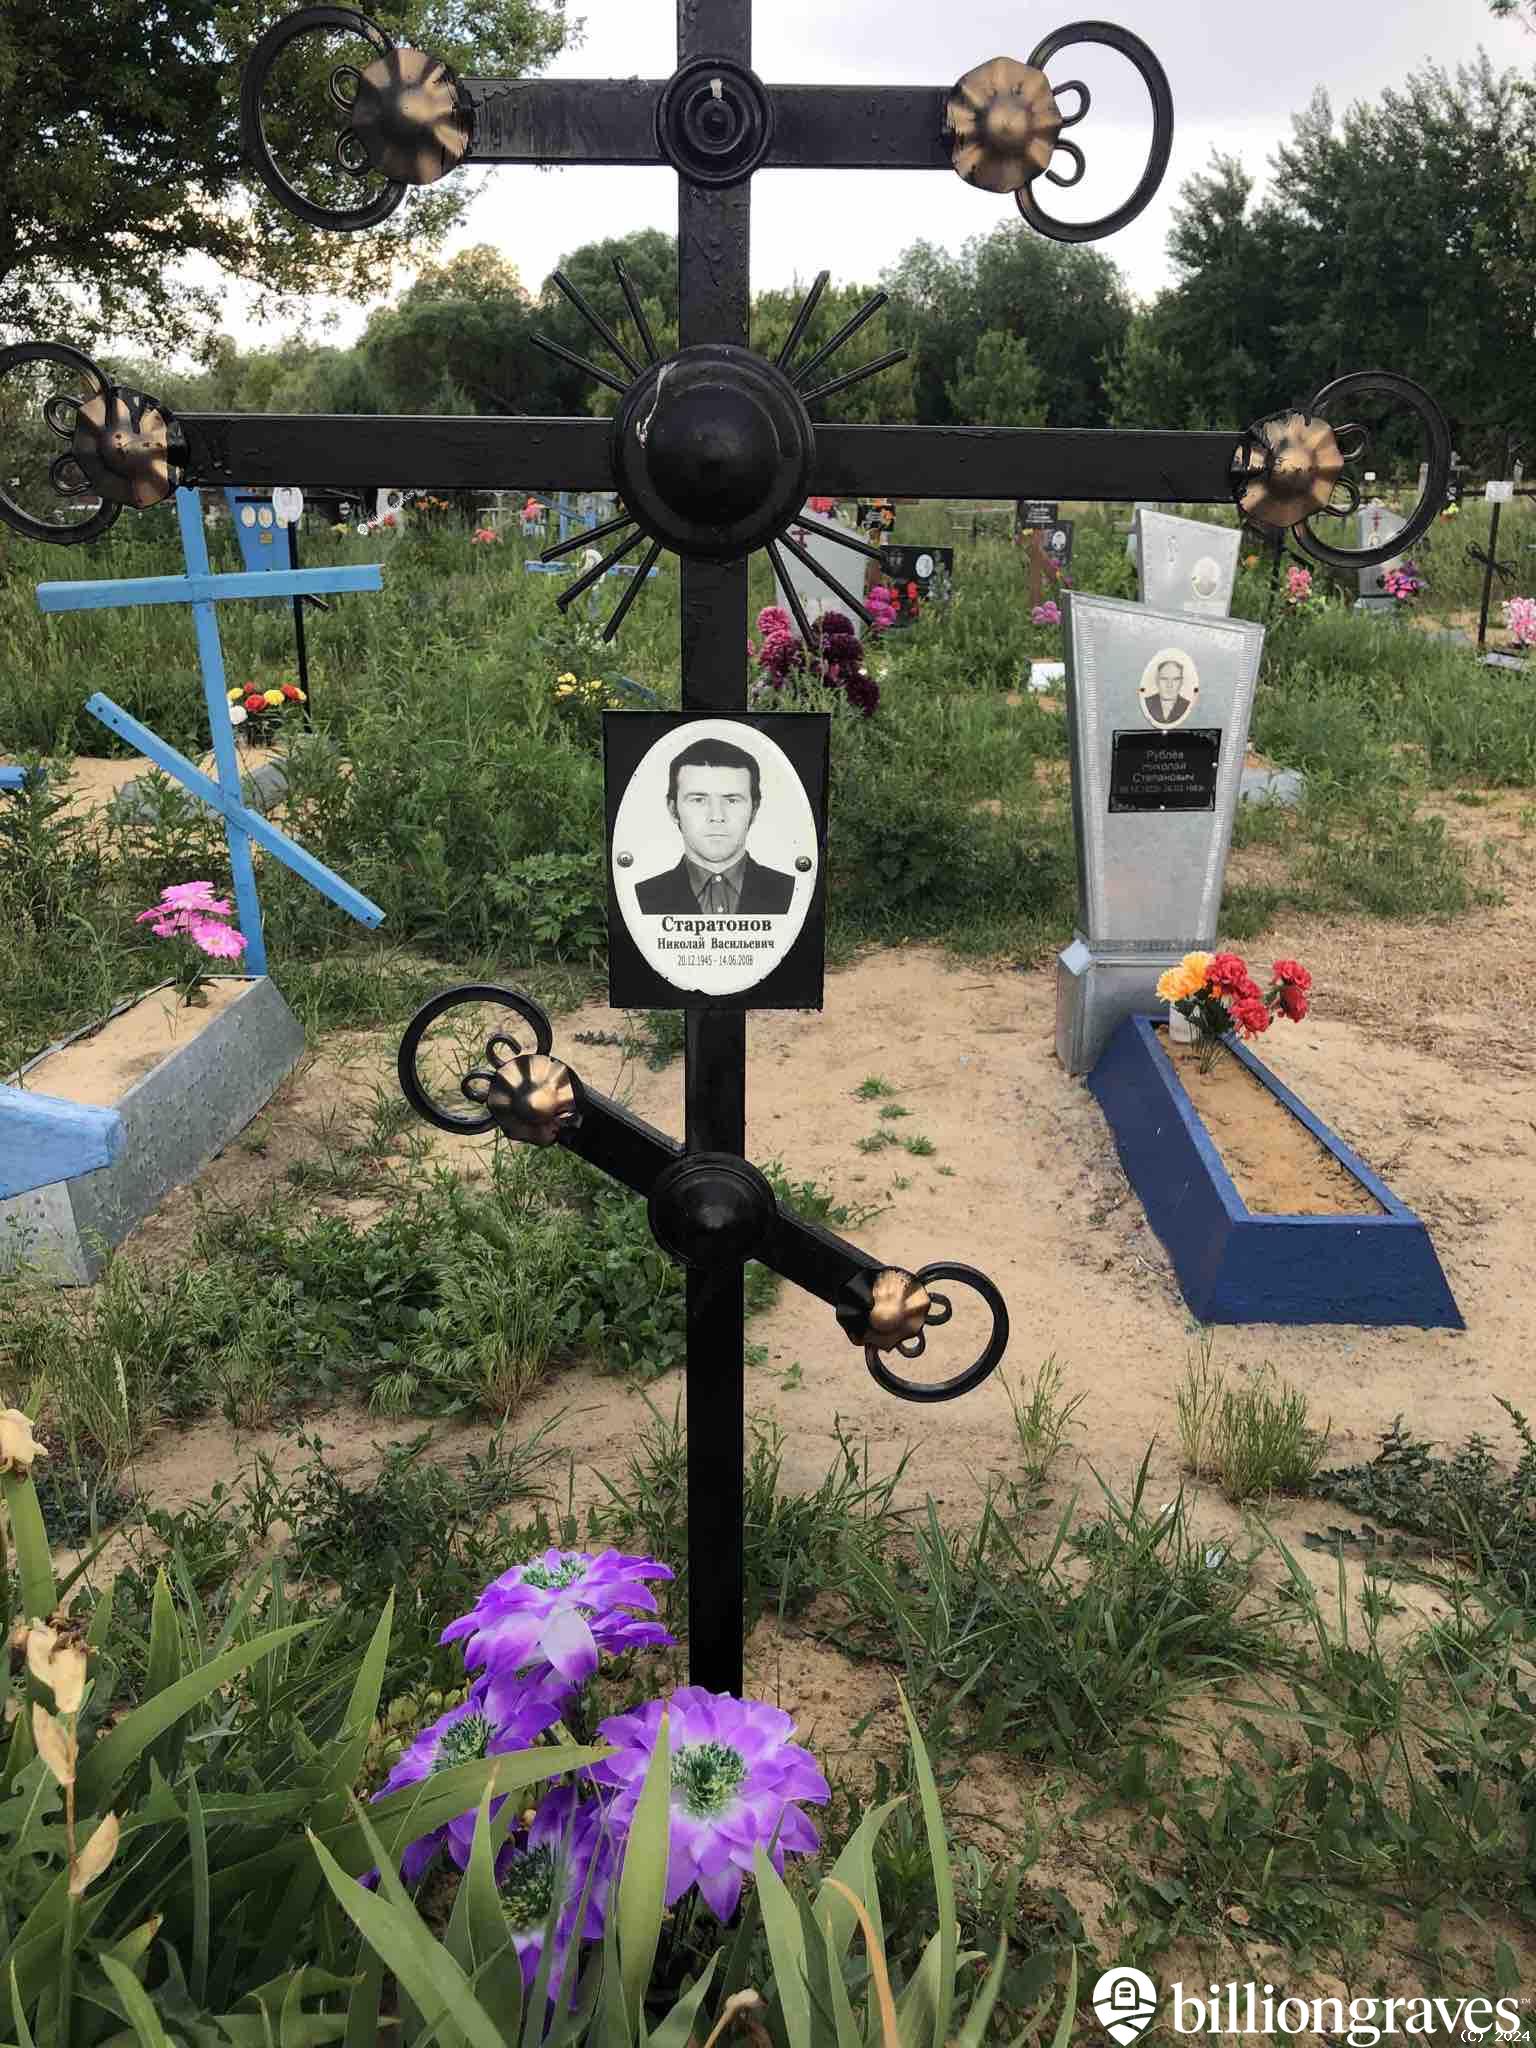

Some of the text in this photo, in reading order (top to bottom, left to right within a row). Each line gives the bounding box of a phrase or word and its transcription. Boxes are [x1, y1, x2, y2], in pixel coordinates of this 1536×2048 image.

[662, 916, 772, 935] Старатонов
[657, 937, 775, 950] Николай Васильевич
[677, 954, 713, 966] 20.12.1945
